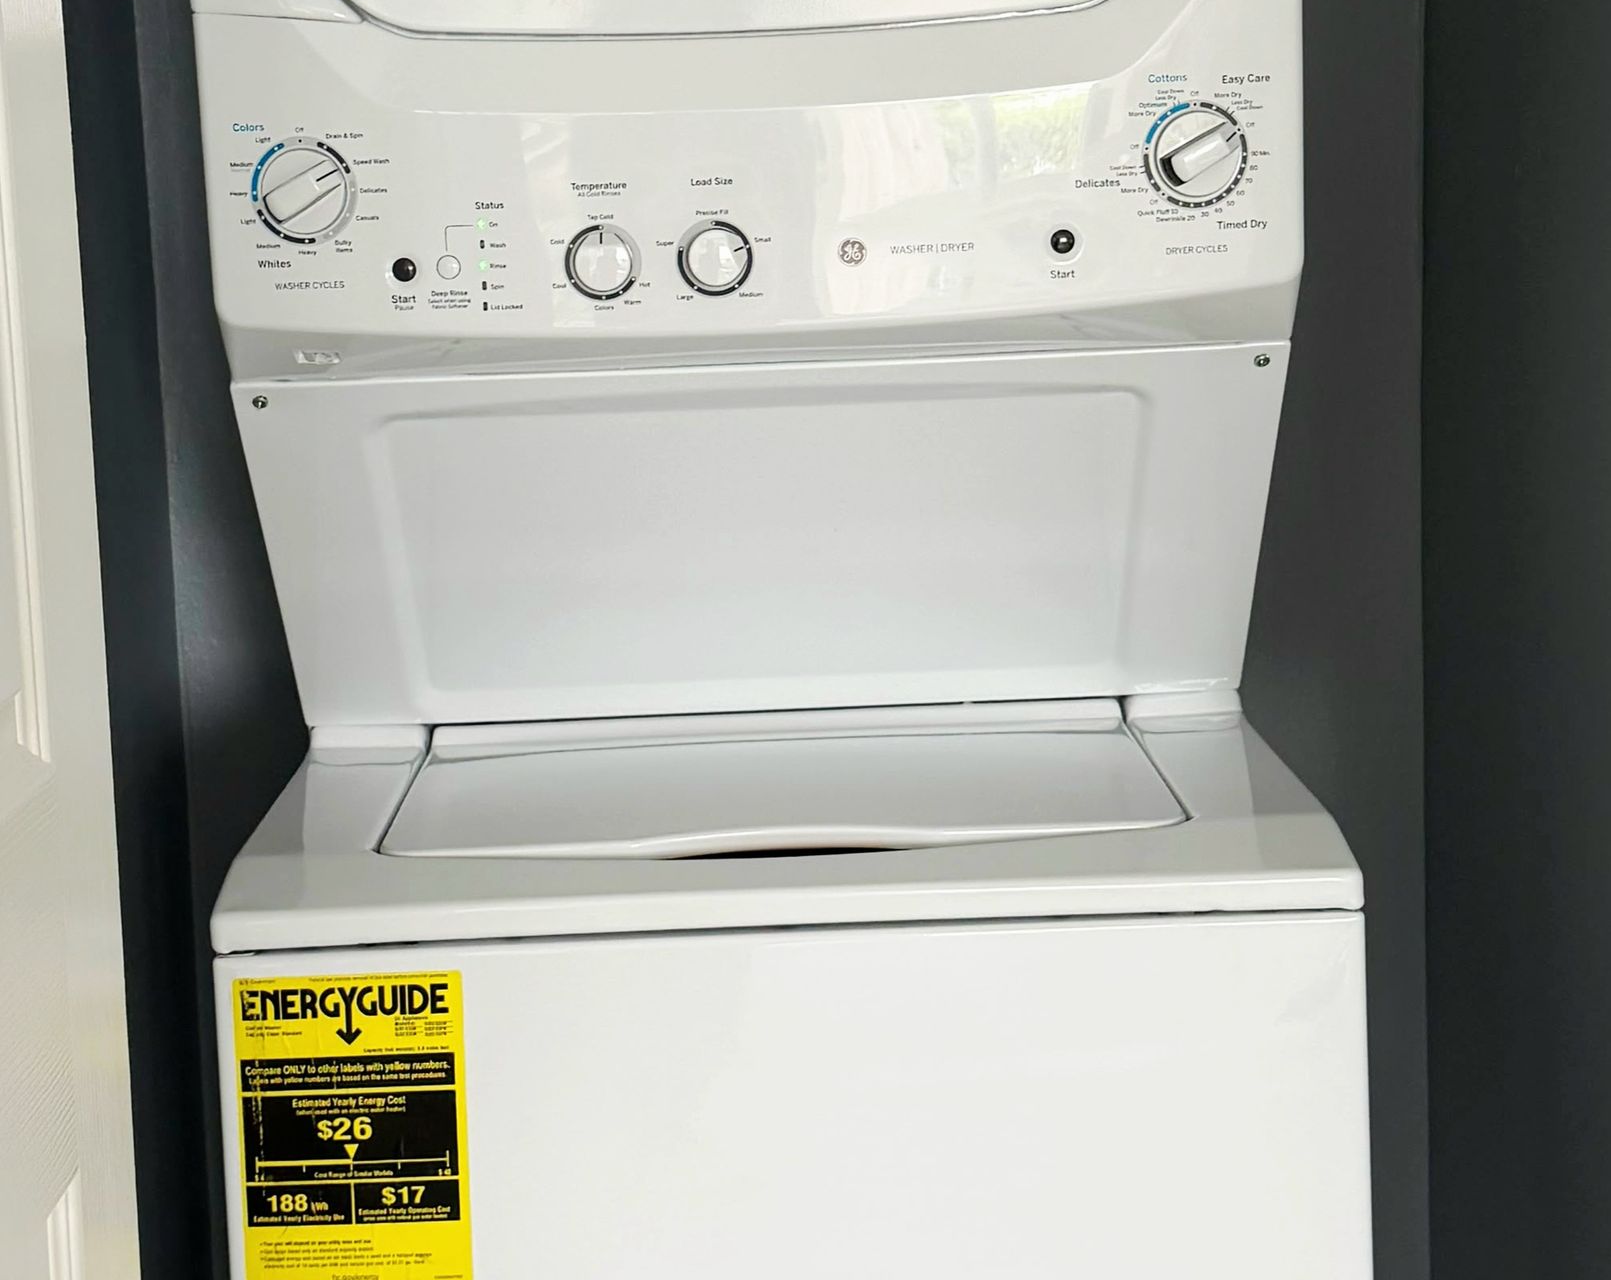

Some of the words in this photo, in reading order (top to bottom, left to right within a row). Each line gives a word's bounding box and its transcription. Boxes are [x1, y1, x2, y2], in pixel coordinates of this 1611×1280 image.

[1148, 74, 1187, 83] Cottons
[1222, 75, 1245, 85] Easy
[1247, 74, 1270, 83] Care
[232, 123, 264, 133] Colors
[570, 182, 627, 191] Temperature
[690, 178, 713, 186] Load
[715, 177, 733, 186] Size
[1075, 179, 1121, 189] Delicates
[475, 201, 504, 210] Status
[1216, 220, 1248, 230] Timed
[1250, 219, 1268, 230] Dry
[1166, 247, 1194, 255] DRYER
[1195, 245, 1228, 253] CYCLES
[258, 260, 292, 269] Whites
[1050, 269, 1075, 279] Start
[275, 281, 310, 290] WASHER
[312, 280, 345, 289] CYCLES
[391, 295, 416, 304] Start
[245, 1066, 281, 1076] Compare
[283, 1065, 306, 1074] ONLY
[307, 1065, 316, 1074] to
[317, 1064, 339, 1073] other
[340, 1063, 364, 1072] labels
[366, 1062, 383, 1071] with
[385, 1061, 411, 1073] yellow
[412, 1060, 451, 1070] numbers.
[284, 1077, 303, 1085] yellow
[292, 1098, 331, 1108] Estimated
[332, 1097, 356, 1108] Yearly
[358, 1096, 386, 1107] Energy
[387, 1095, 406, 1104] Cost
[317, 1116, 373, 1141] $26
[381, 1185, 426, 1206] $17
[267, 1193, 308, 1212] 188
[388, 1207, 406, 1216] Yearly
[283, 1215, 301, 1223] Yearly
[302, 1214, 331, 1222] Electricity
